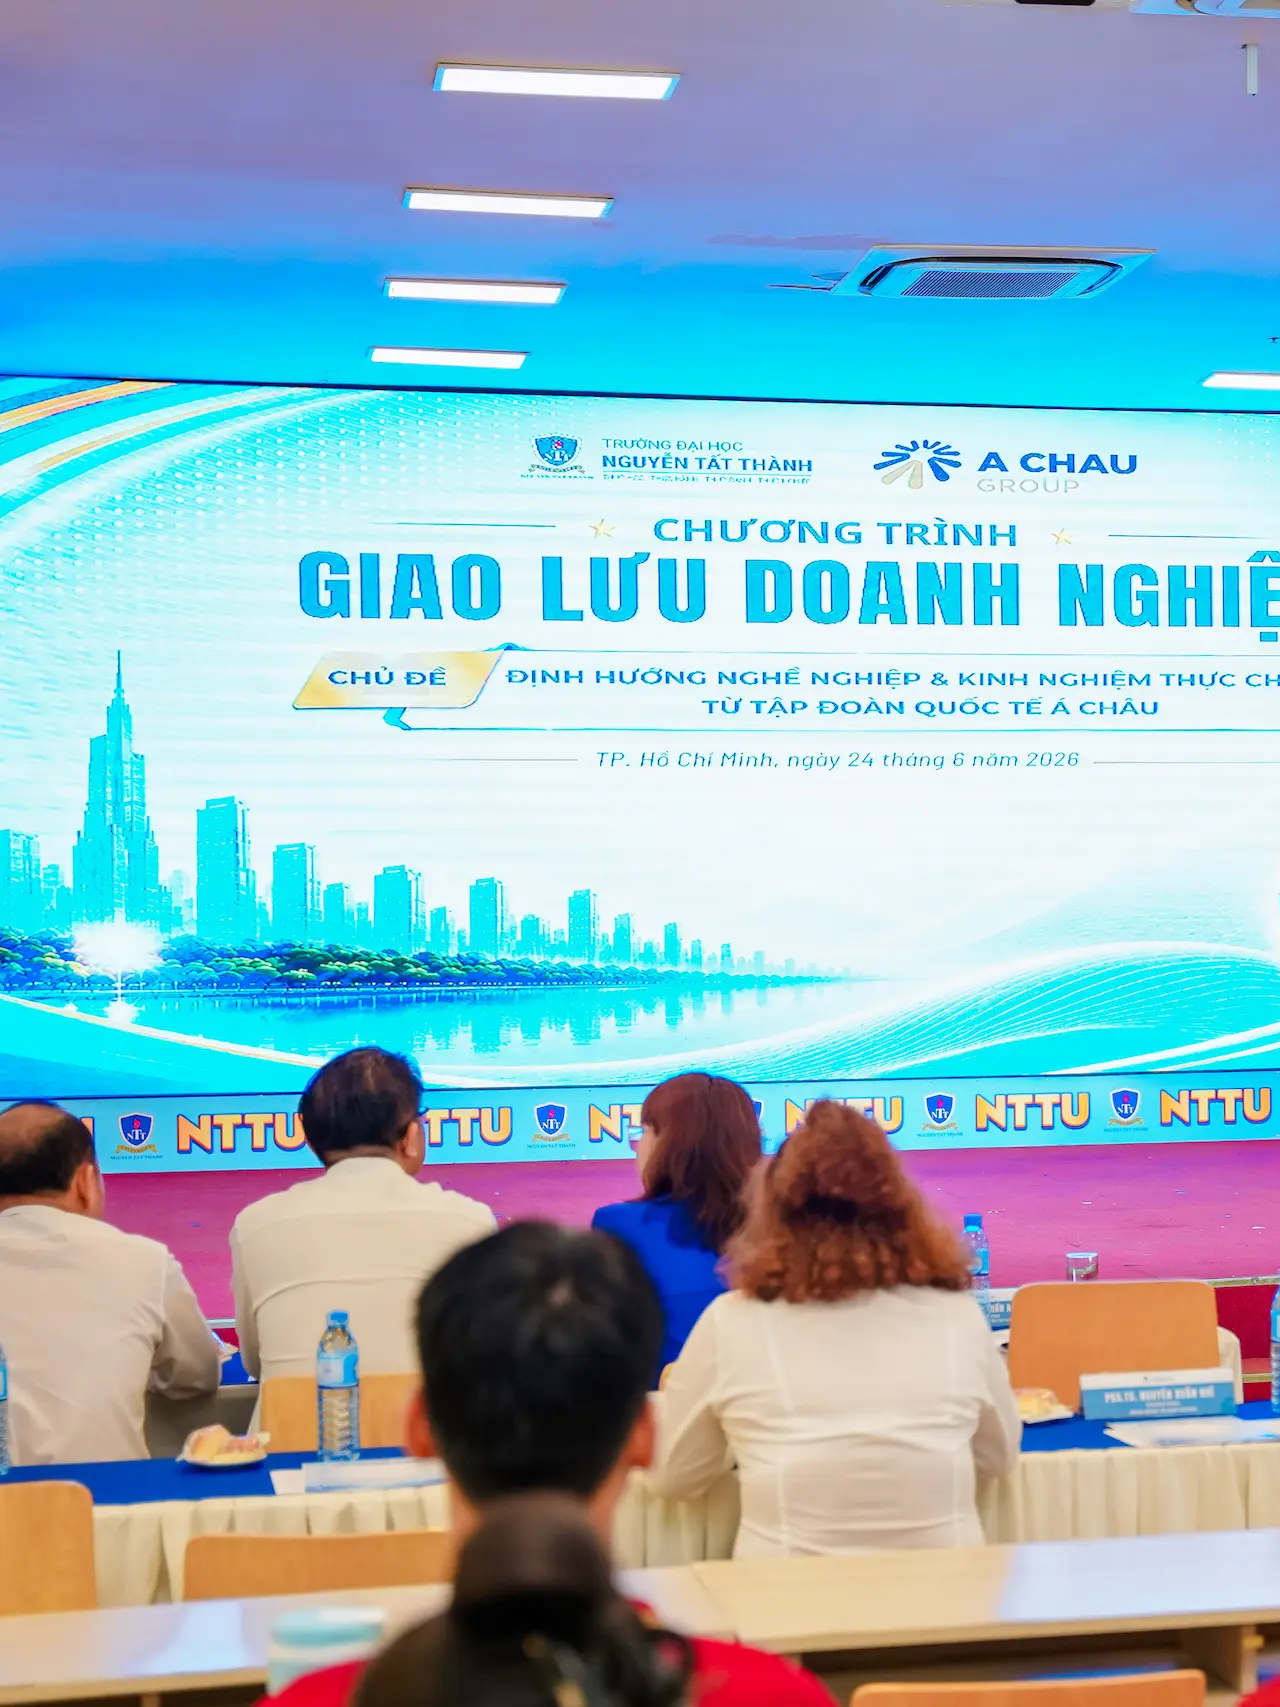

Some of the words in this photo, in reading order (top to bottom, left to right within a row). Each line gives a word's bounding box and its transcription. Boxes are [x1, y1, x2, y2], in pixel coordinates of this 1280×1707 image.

[602, 438, 671, 451] TRƯỜNG
[677, 440, 703, 452] ĐẠI
[708, 441, 743, 452] HỌC
[602, 452, 689, 469] NGUYỄN
[694, 454, 733, 470] TẤT
[738, 456, 813, 472] THÀNH
[977, 452, 1009, 472] A
[1020, 452, 1138, 474] CHAU
[976, 478, 1080, 493] GROUP
[653, 518, 863, 546] CHƯƠNG
[878, 517, 1017, 547] TRÌNH
[299, 550, 502, 620] GIAO
[542, 551, 706, 624] LƯU
[745, 559, 1020, 627] DOANH
[328, 665, 395, 686] CHỦ
[404, 665, 446, 686] ĐỀ
[505, 669, 584, 690] ĐỊNH
[596, 665, 706, 686] HƯỚNG
[717, 665, 799, 687] NGHỀ
[811, 667, 921, 690] NGHIỆP
[931, 672, 949, 686] &
[958, 672, 1028, 686] KINH
[1039, 668, 1151, 690] NGHIỆM
[1160, 671, 1236, 690] THỰC
[702, 695, 741, 714] TỪ
[753, 696, 808, 717] TẬP
[816, 695, 902, 715] ĐOÀN
[914, 697, 999, 717] QUỐC
[1009, 697, 1042, 715] TẾ
[1050, 697, 1072, 715] Á
[1079, 699, 1160, 716] CHÂU
[597, 752, 630, 767] TP.
[641, 748, 669, 767] Hồ
[678, 751, 713, 767] Chí
[722, 752, 778, 770] Minh,
[787, 752, 840, 773] ngày
[847, 752, 877, 767] 24
[882, 752, 944, 771] tháng
[952, 752, 965, 767] 6
[971, 753, 1018, 767] năm
[1026, 752, 1079, 767] 2026
[976, 1091, 1090, 1131] NTTU
[1160, 1086, 1272, 1126] NTTU
[127, 1129, 147, 1140] NTT
[177, 1112, 307, 1154] NTTU
[423, 1106, 513, 1147] TTU
